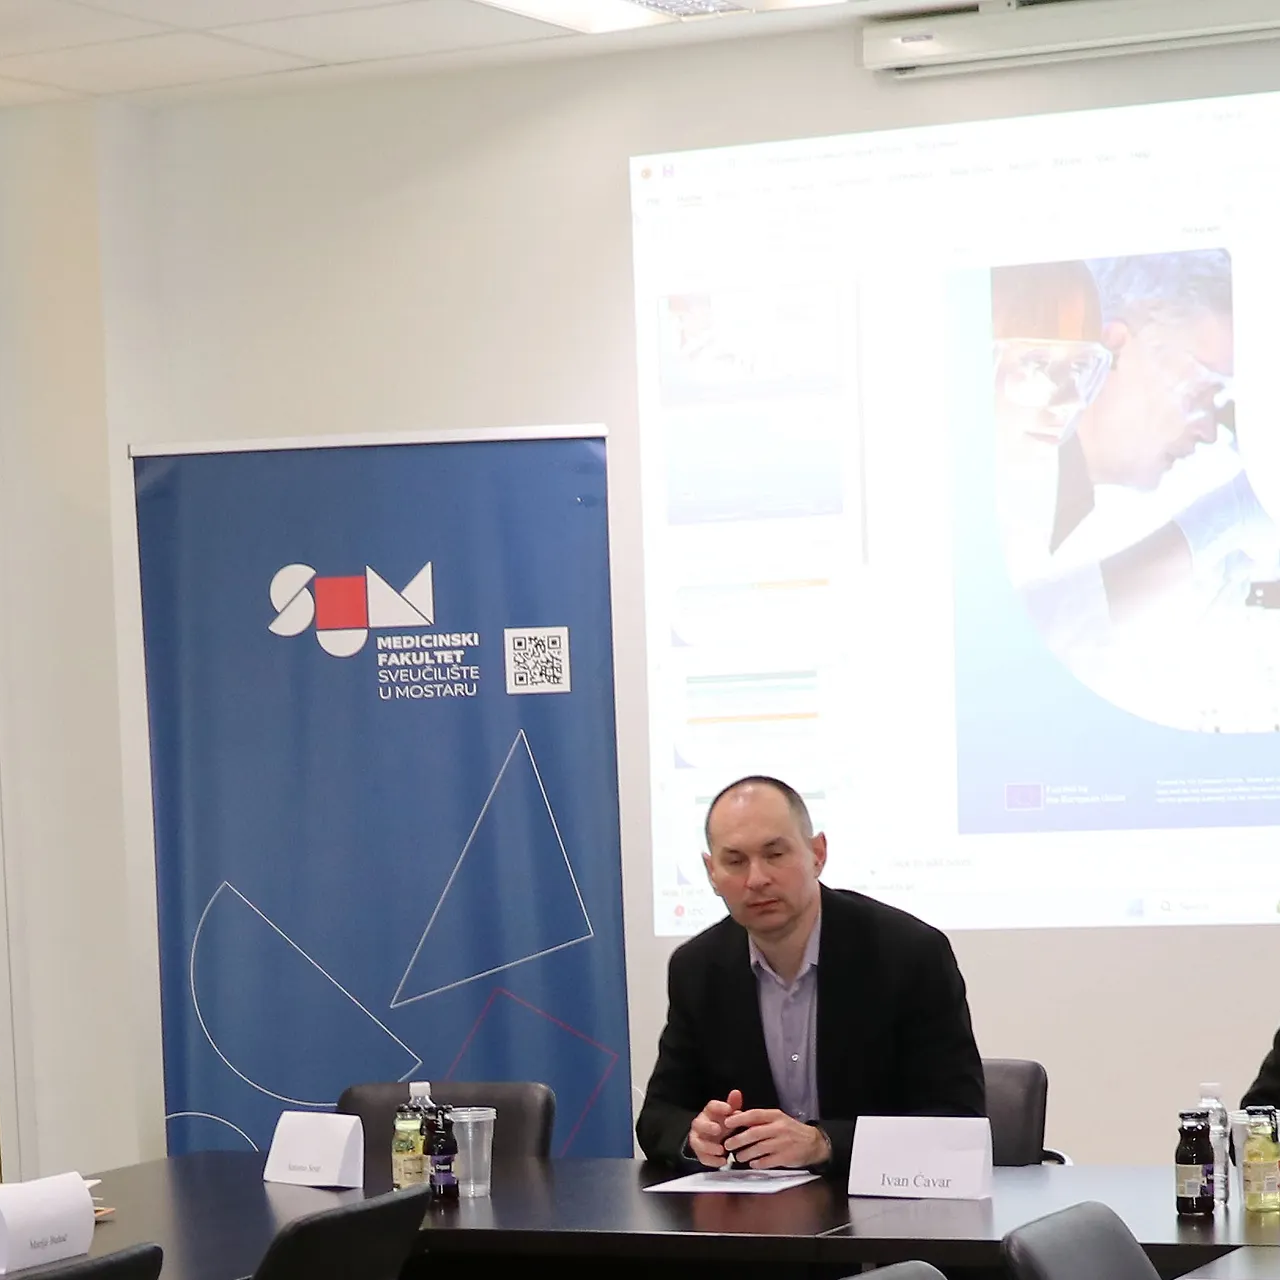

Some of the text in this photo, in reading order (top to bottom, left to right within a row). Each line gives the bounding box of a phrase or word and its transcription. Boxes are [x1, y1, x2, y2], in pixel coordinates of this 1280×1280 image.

[377, 632, 480, 649] MEDICINSKI
[377, 650, 465, 666] FAKULTET
[378, 664, 480, 683] SVEUČILIŠTE
[379, 683, 477, 700] U MOSTARU
[880, 1173, 909, 1187] Ivan
